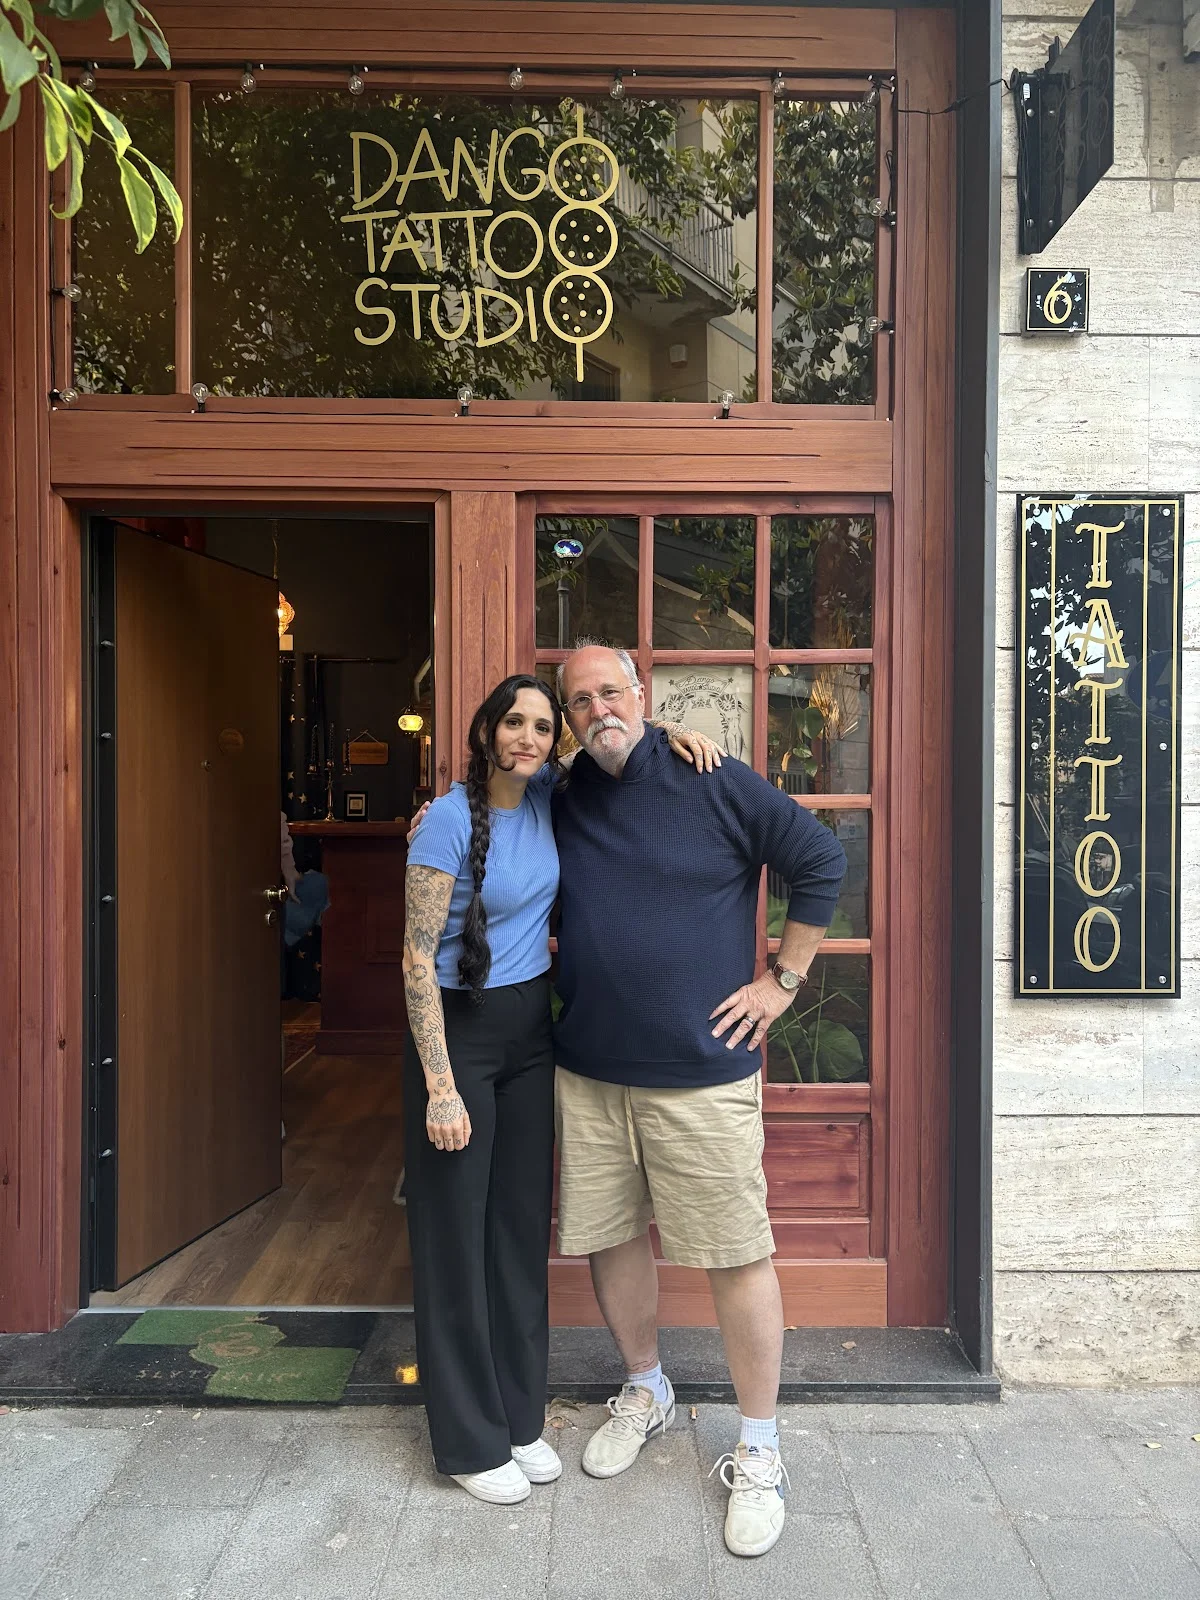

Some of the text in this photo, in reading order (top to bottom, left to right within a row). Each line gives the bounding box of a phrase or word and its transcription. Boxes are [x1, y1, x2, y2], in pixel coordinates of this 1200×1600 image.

[350, 127, 620, 210] DANGO
[341, 209, 619, 280] TATTOO
[354, 268, 614, 348] STUDIO
[1043, 271, 1073, 324] 6
[1068, 521, 1130, 973] TATTOO
